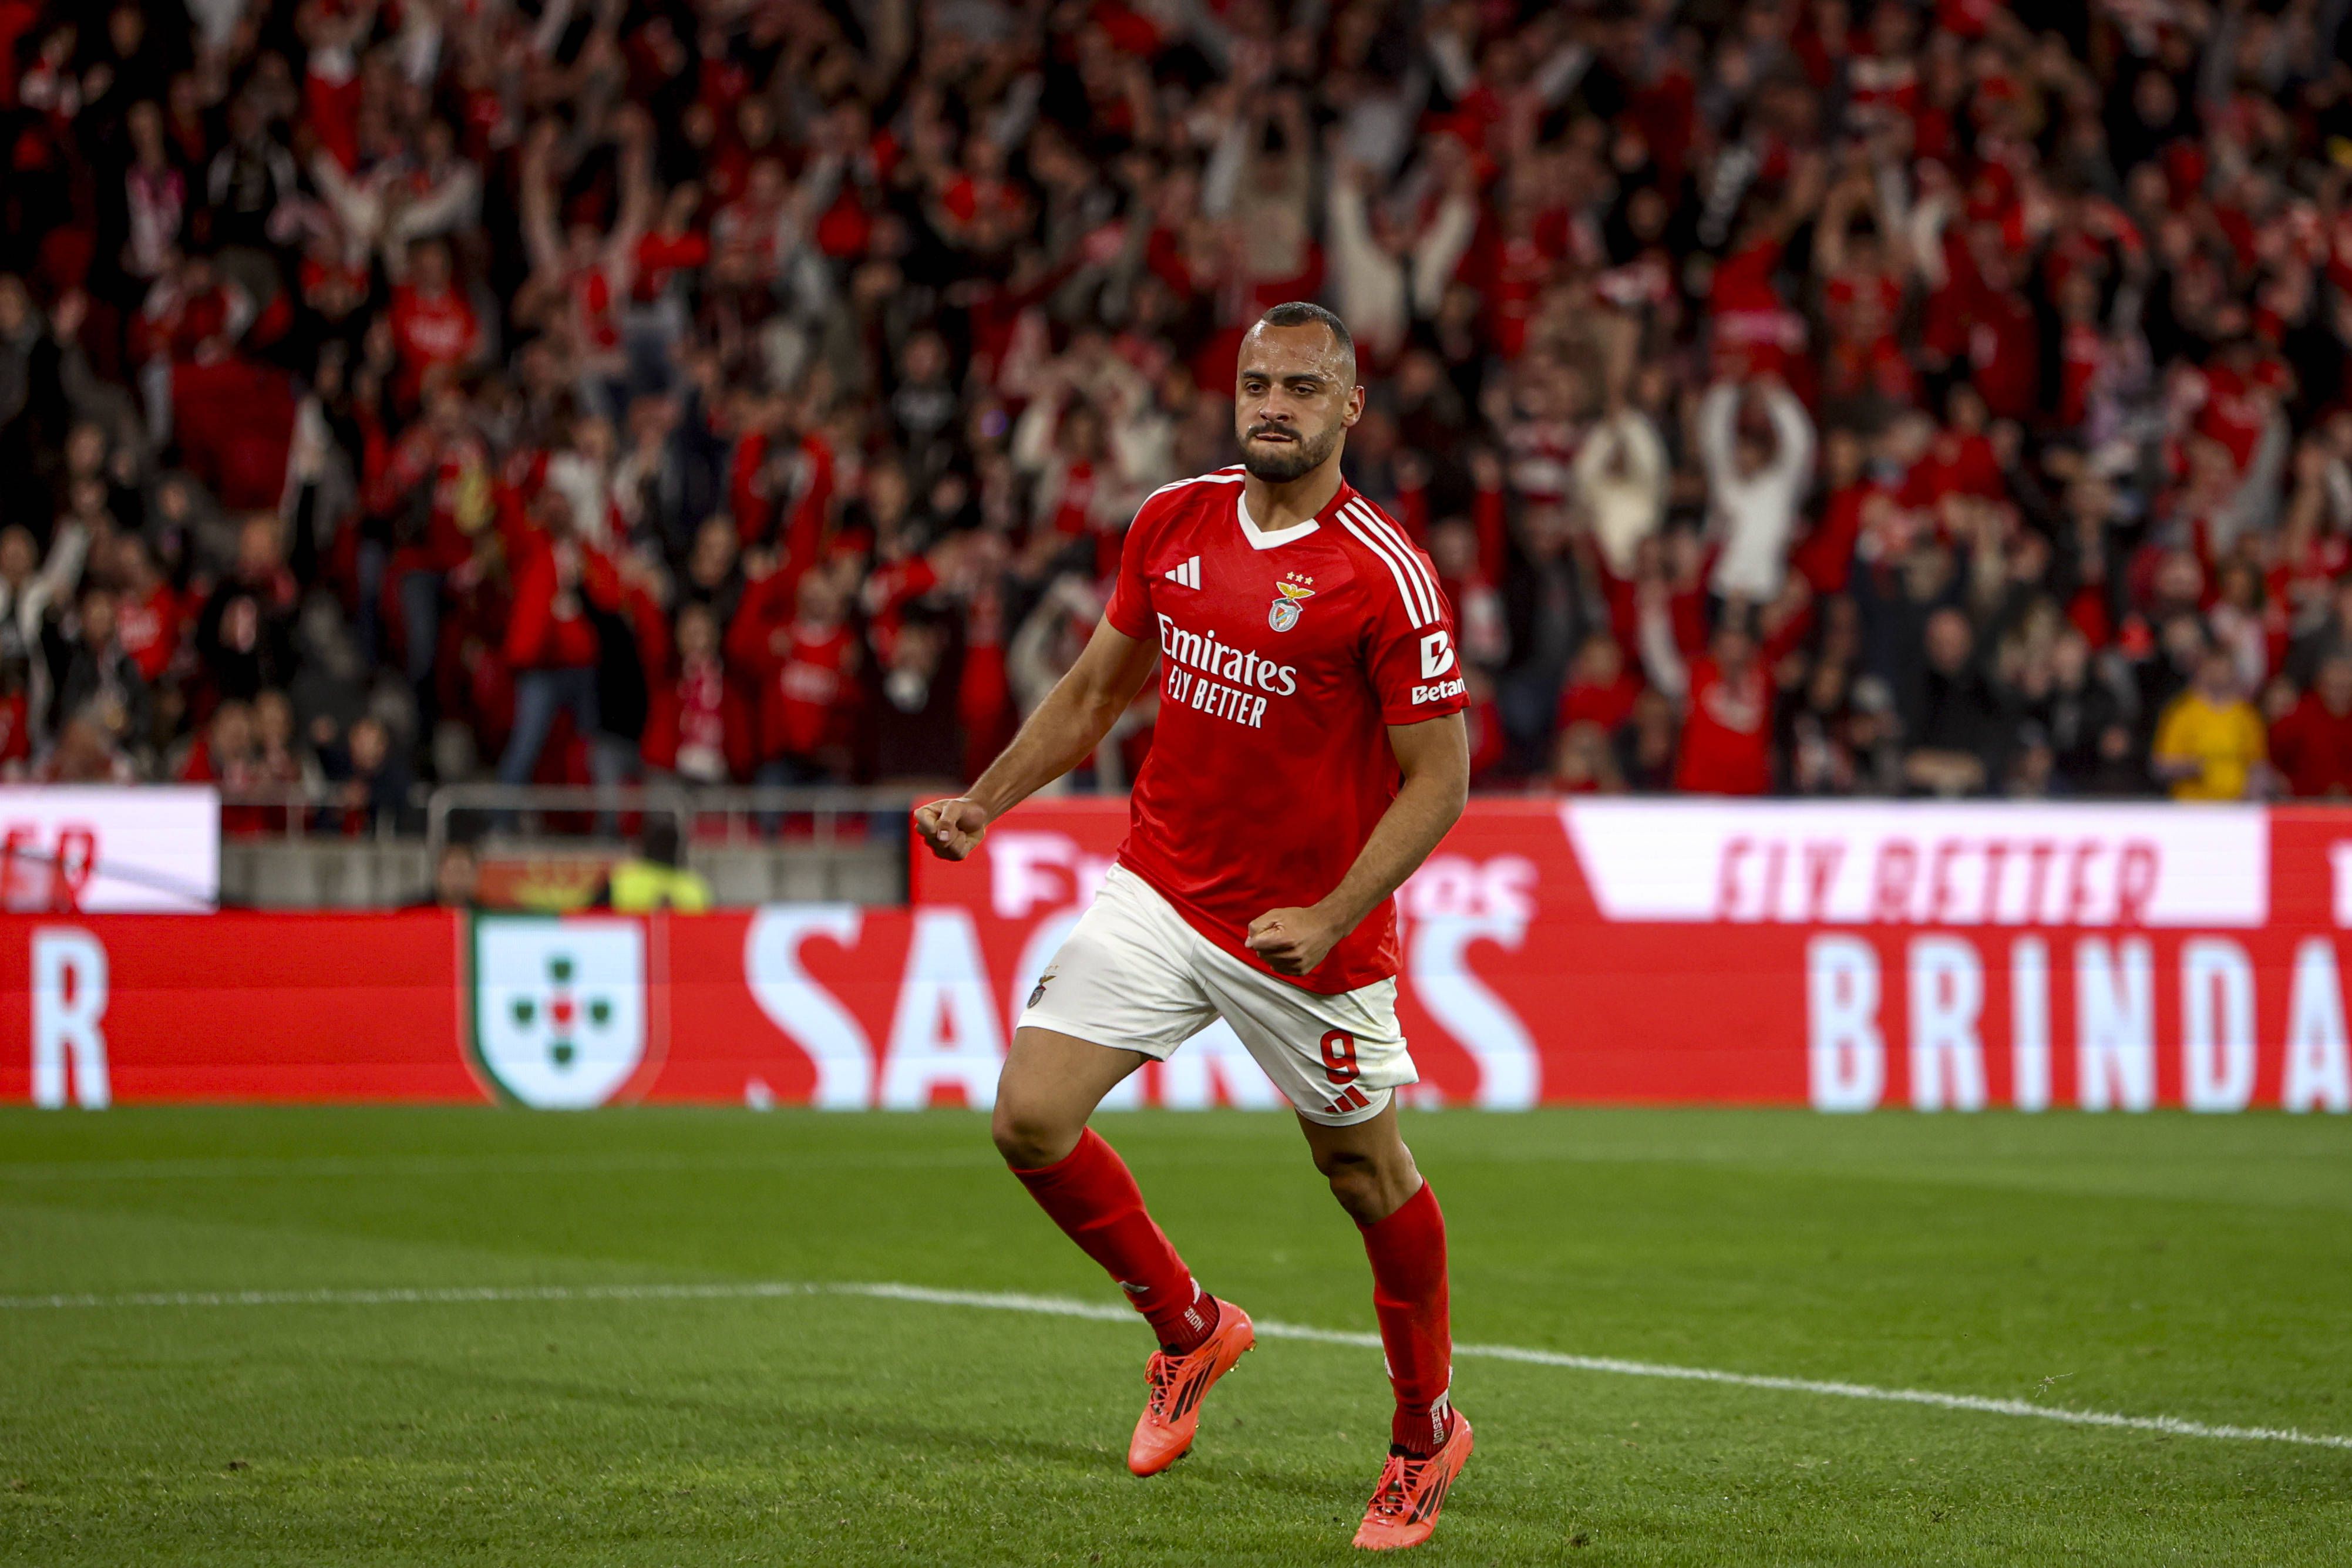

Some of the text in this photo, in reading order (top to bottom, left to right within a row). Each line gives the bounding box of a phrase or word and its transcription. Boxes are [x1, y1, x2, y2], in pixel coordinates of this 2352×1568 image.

[1157, 612, 1296, 696] Emirates
[1168, 665, 1267, 729] FLY BETTER
[1412, 677, 1466, 705] Betan
[29, 924, 112, 1111] R
[1805, 931, 2352, 1113] BRINDA
[1320, 1029, 1360, 1085] 9
[1183, 1305, 1206, 1333] SIGN
